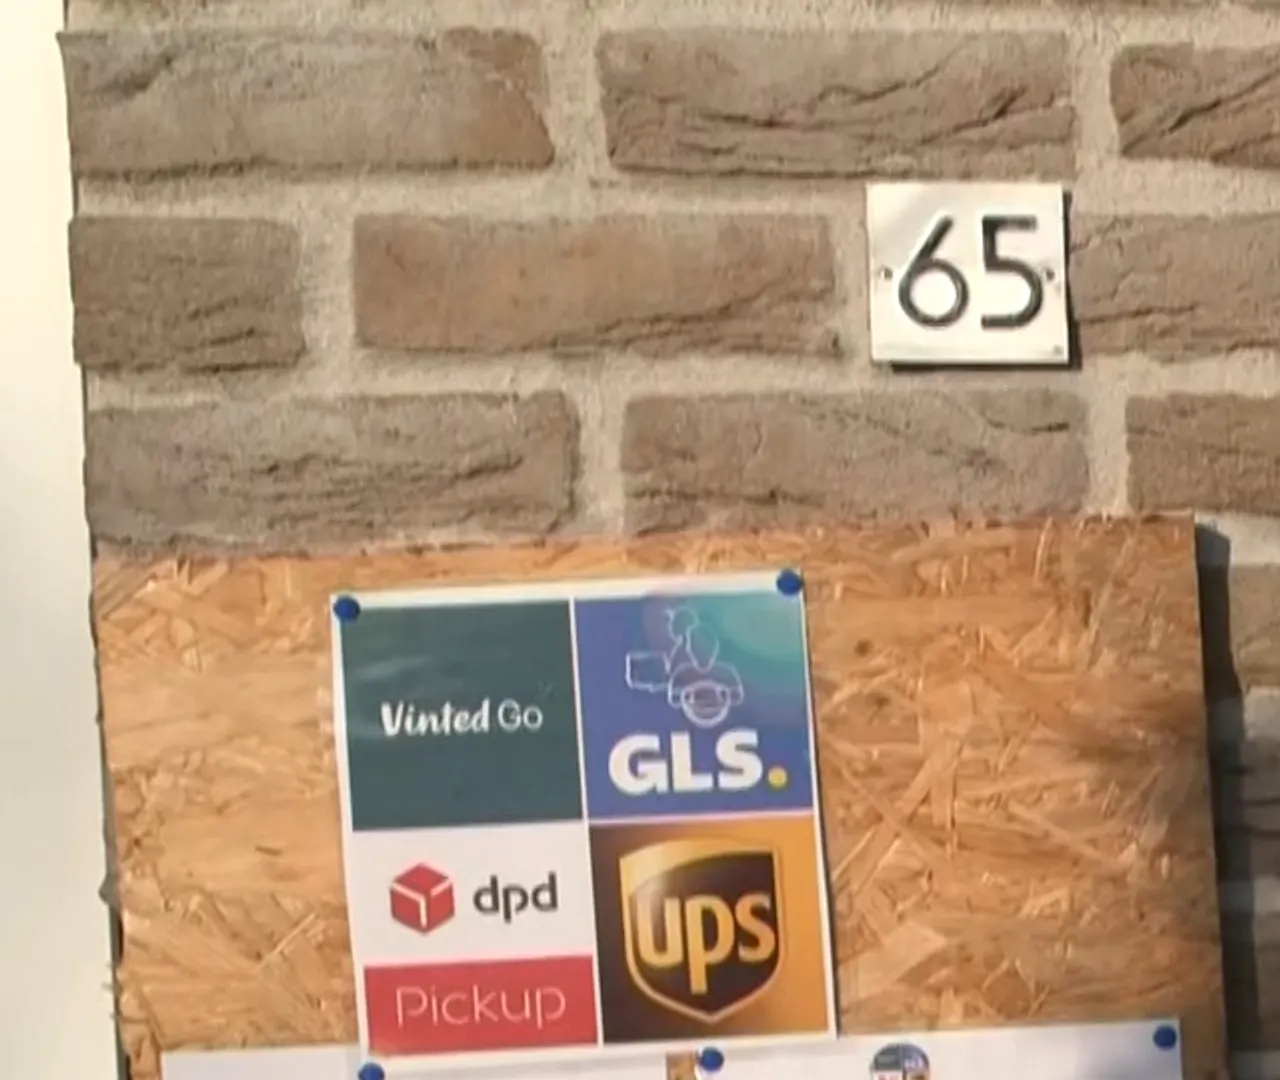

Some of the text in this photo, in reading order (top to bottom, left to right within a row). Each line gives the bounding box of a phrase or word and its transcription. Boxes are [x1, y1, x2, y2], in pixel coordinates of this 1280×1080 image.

[898, 214, 1043, 329] 65
[380, 697, 543, 737] Vinted Go
[472, 871, 559, 924] dpd
[634, 893, 778, 995] ups
[395, 984, 566, 1030] Pickup
